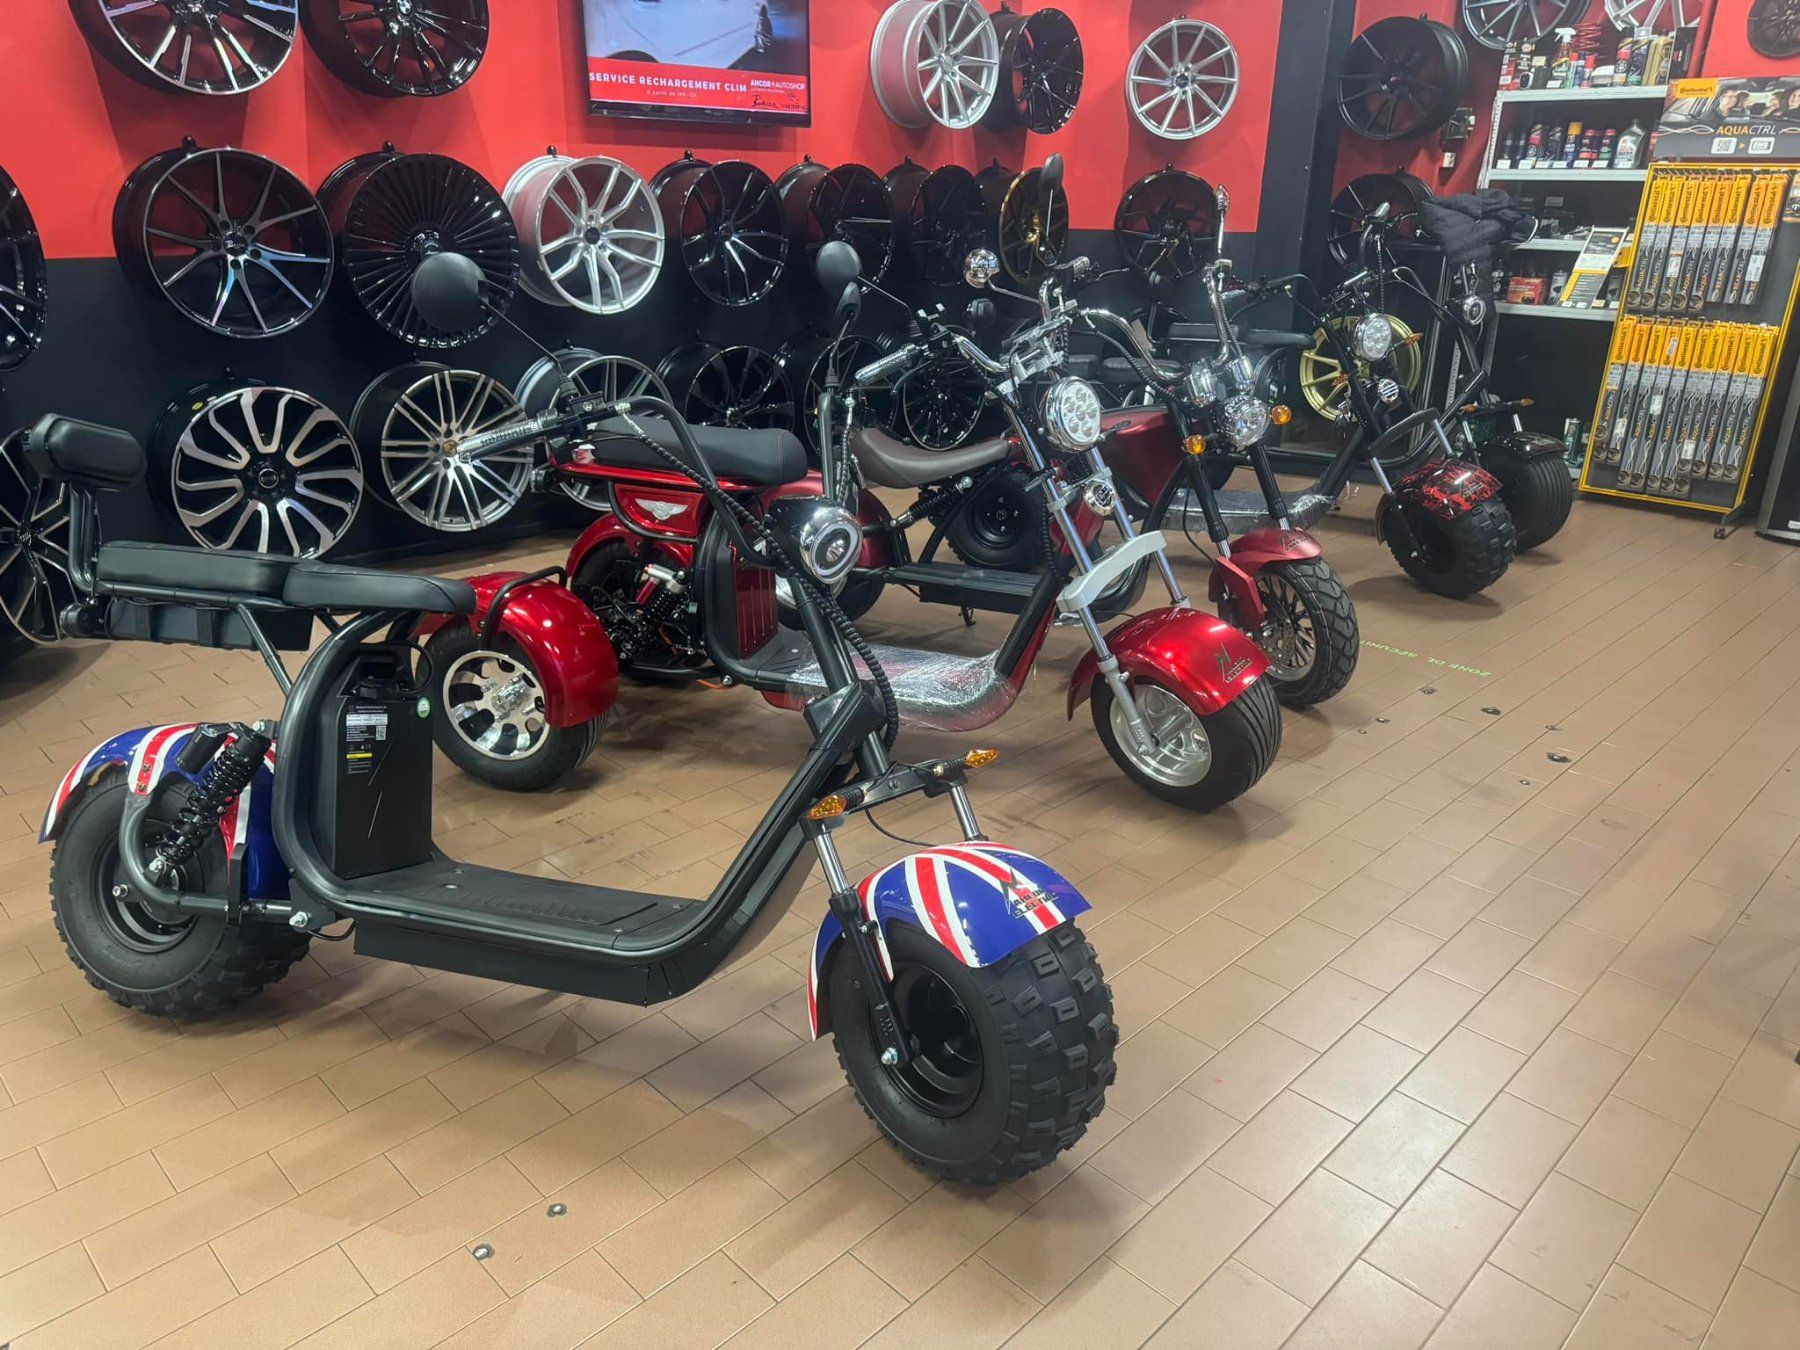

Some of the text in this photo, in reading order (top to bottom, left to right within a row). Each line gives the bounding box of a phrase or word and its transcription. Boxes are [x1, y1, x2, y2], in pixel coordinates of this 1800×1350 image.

[589, 72, 635, 84] SERVICE
[639, 76, 721, 90] RECHARGEMENT
[724, 83, 747, 92] CLIM
[1716, 125, 1776, 135] AQUACTRL
[1448, 663, 1492, 677] ZONE
